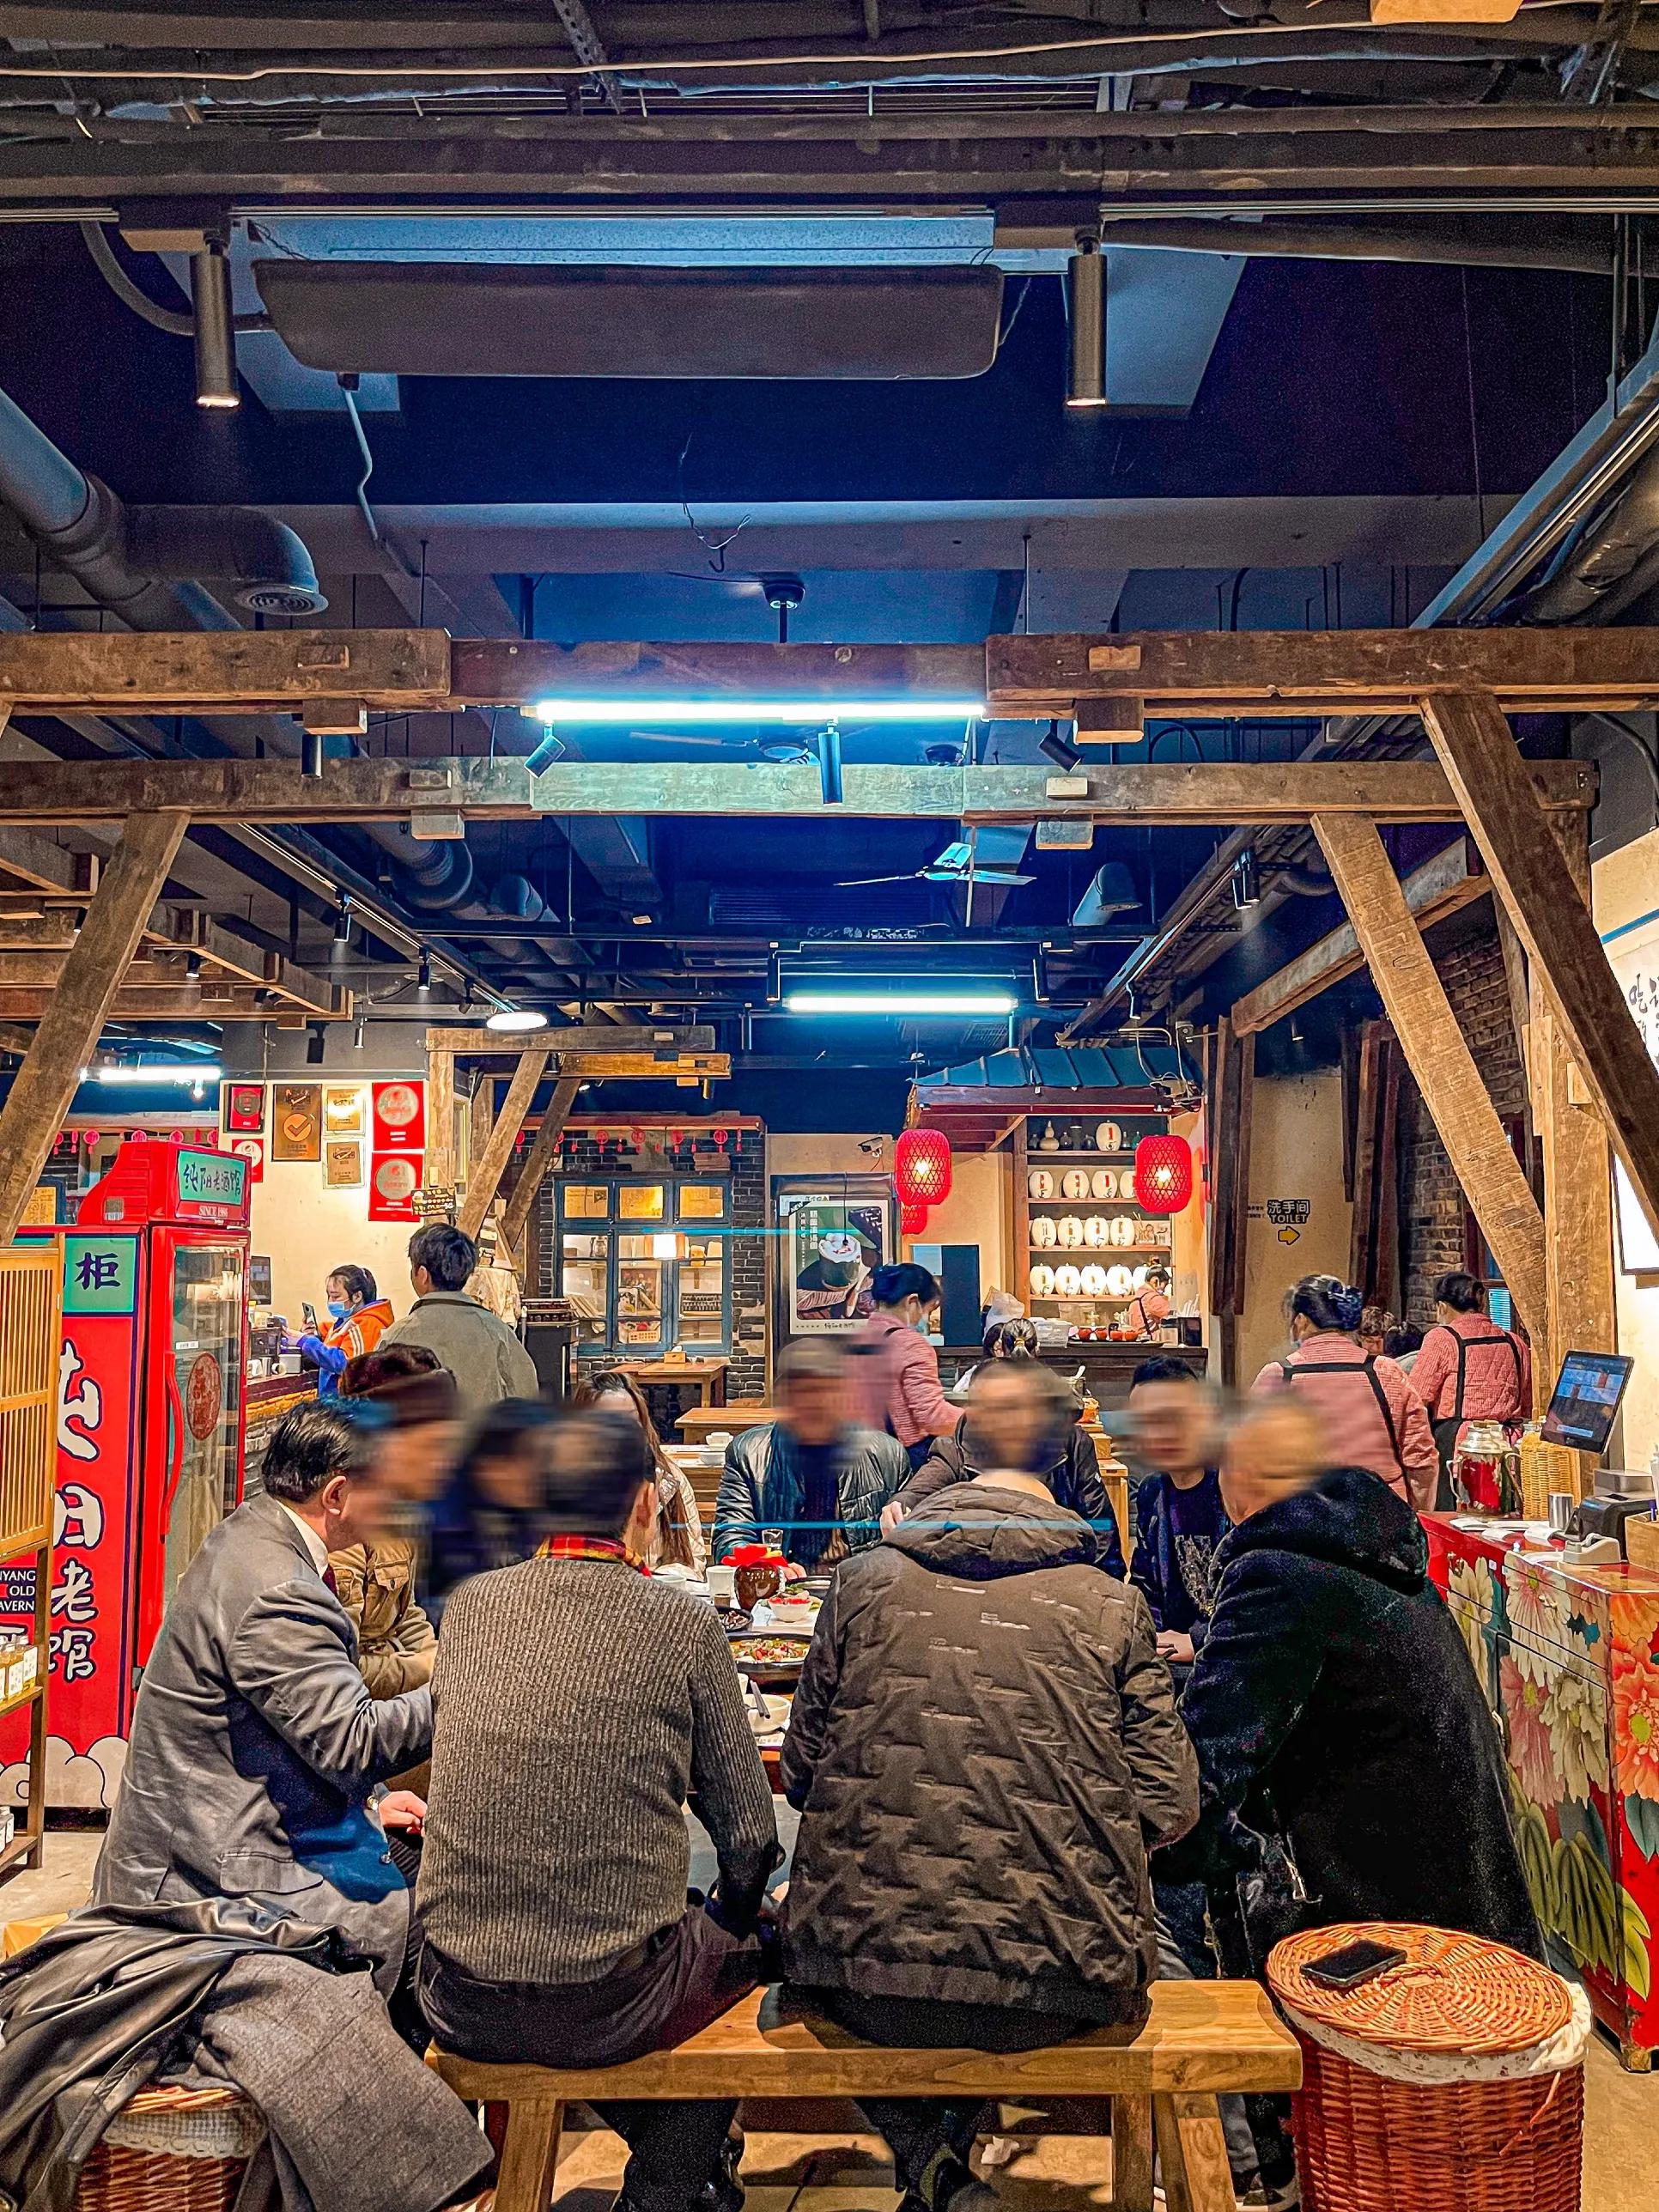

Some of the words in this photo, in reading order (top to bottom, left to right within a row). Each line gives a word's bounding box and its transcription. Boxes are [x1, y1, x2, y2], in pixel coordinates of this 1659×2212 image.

[198, 1205, 217, 1217] SINCE
[1267, 1200, 1310, 1214] 洗手间
[1271, 1214, 1307, 1223] TOILET
[63, 1251, 121, 1290] 柜
[9, 1585, 35, 1596] OLD
